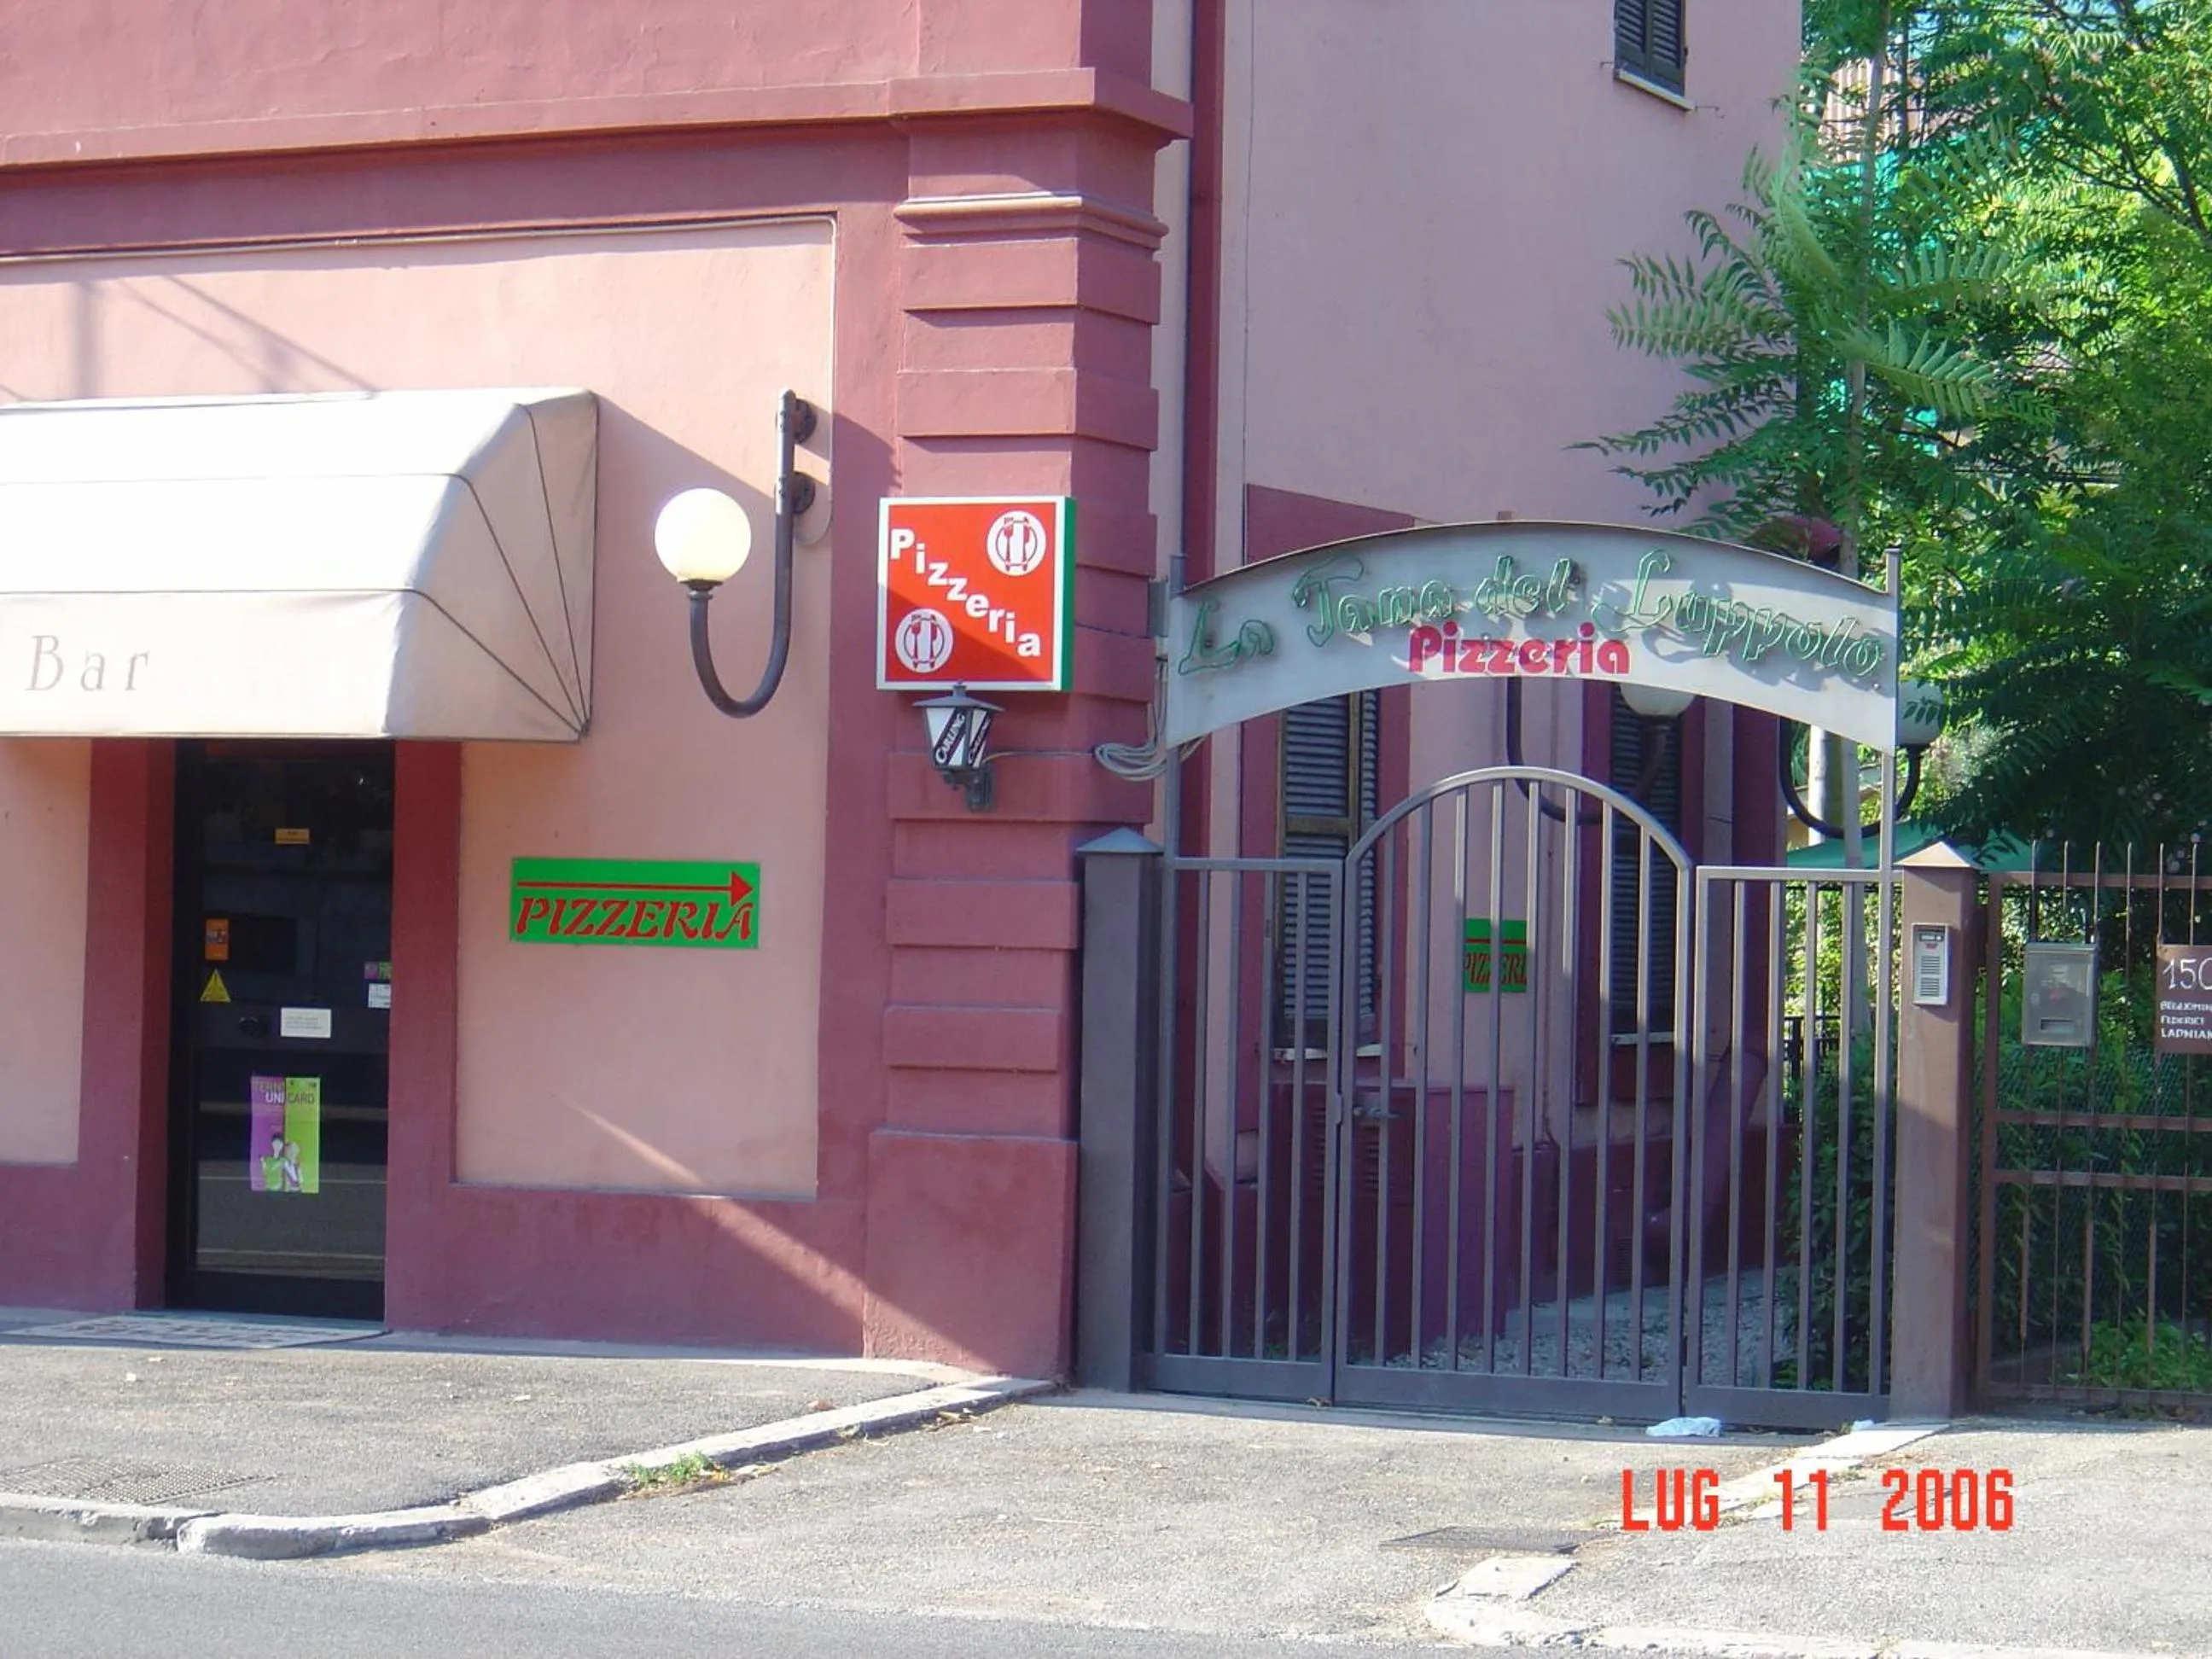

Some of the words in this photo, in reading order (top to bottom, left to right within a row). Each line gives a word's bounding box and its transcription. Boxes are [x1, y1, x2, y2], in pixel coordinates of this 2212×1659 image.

[890, 528, 1041, 657] Pizzeria
[1178, 597, 1275, 677] La
[1291, 553, 1455, 648] Tana
[1475, 555, 1572, 616] del
[1591, 549, 1879, 677] Luppolo
[25, 634, 150, 692] Bar
[1408, 620, 1630, 674] Pizzeria
[515, 897, 754, 940] PIZZERIA
